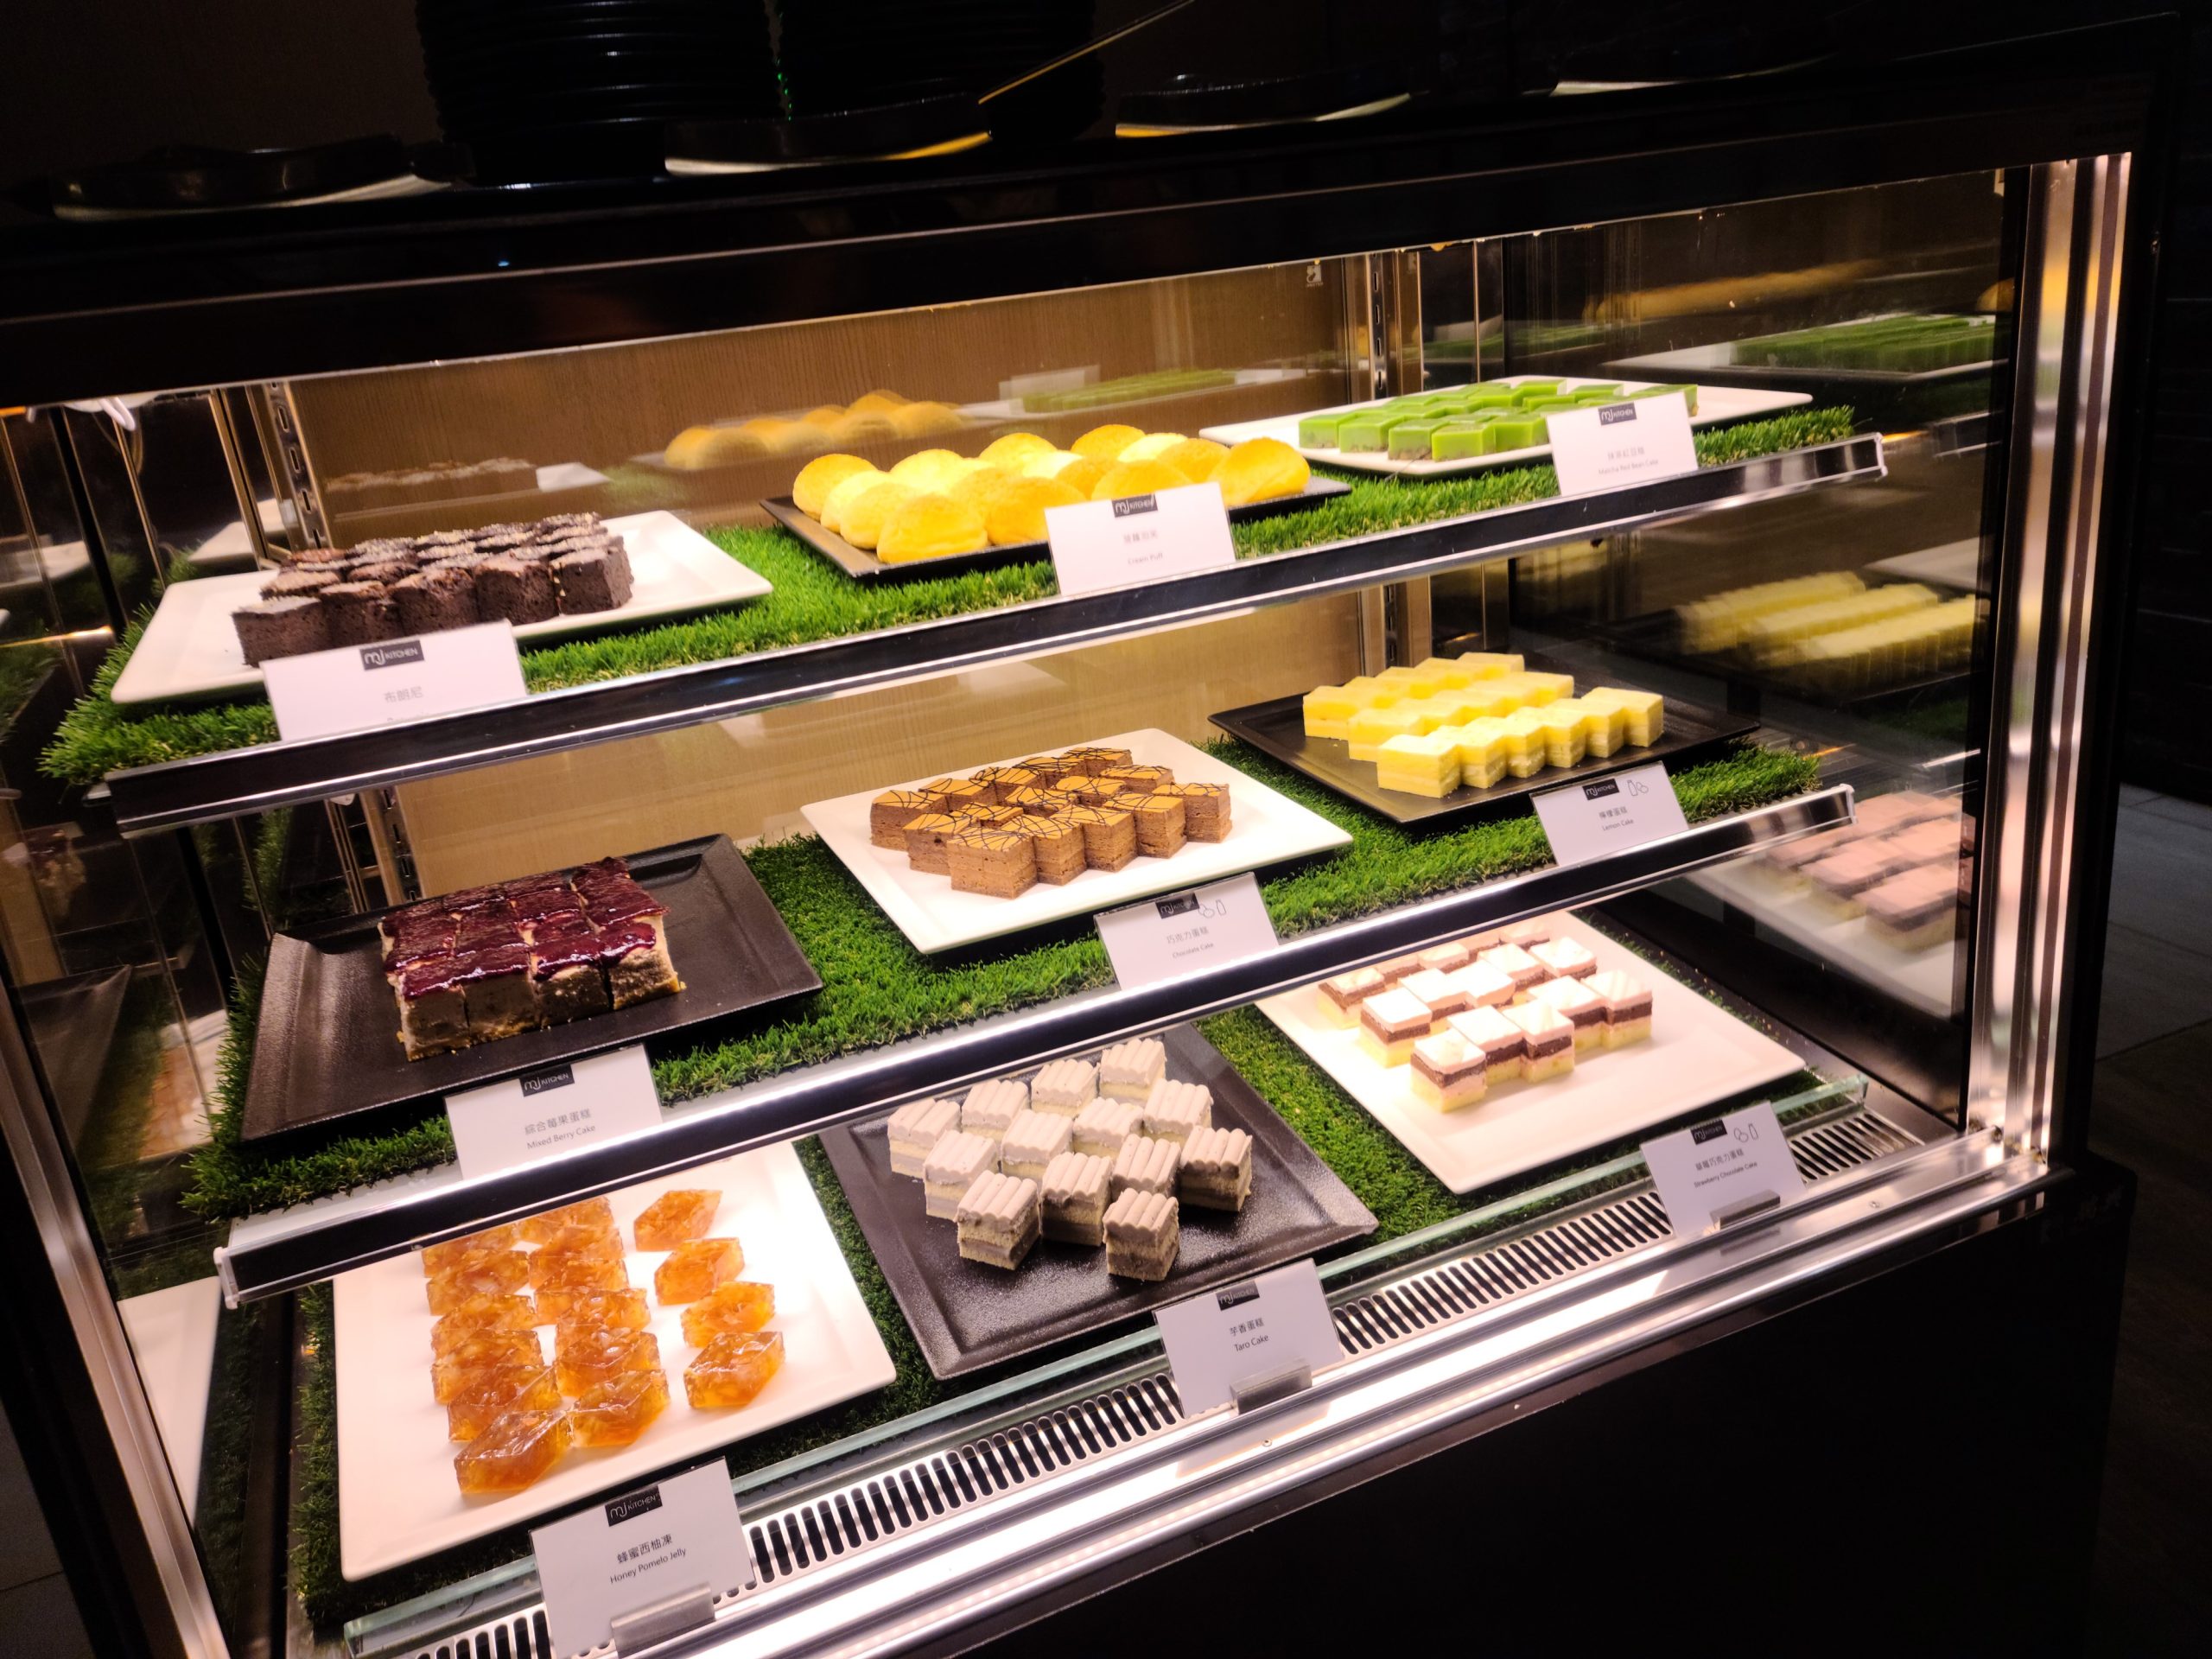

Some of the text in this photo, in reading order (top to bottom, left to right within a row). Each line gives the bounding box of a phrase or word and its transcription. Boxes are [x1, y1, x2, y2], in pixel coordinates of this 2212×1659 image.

[385, 647, 418, 660] KITCHEN
[384, 686, 423, 702] 布朗尼
[1598, 784, 1616, 792] KITCHEN
[1602, 823, 1621, 831] Lemon
[1166, 926, 1210, 944] 巧克力蛋糕
[1173, 942, 1214, 958] Chocolate Cake
[541, 1073, 569, 1085] KITCHEN
[527, 1124, 596, 1149] Mixed Berry Cake
[1694, 1160, 1758, 1188] Strawberry Chocolate Cake
[1229, 1317, 1264, 1337] 芋香蛋糕
[1234, 1334, 1269, 1352] Taro Cake
[628, 1495, 656, 1510] KITCHEN
[610, 1548, 687, 1584] Honey Pomelo Jelly
